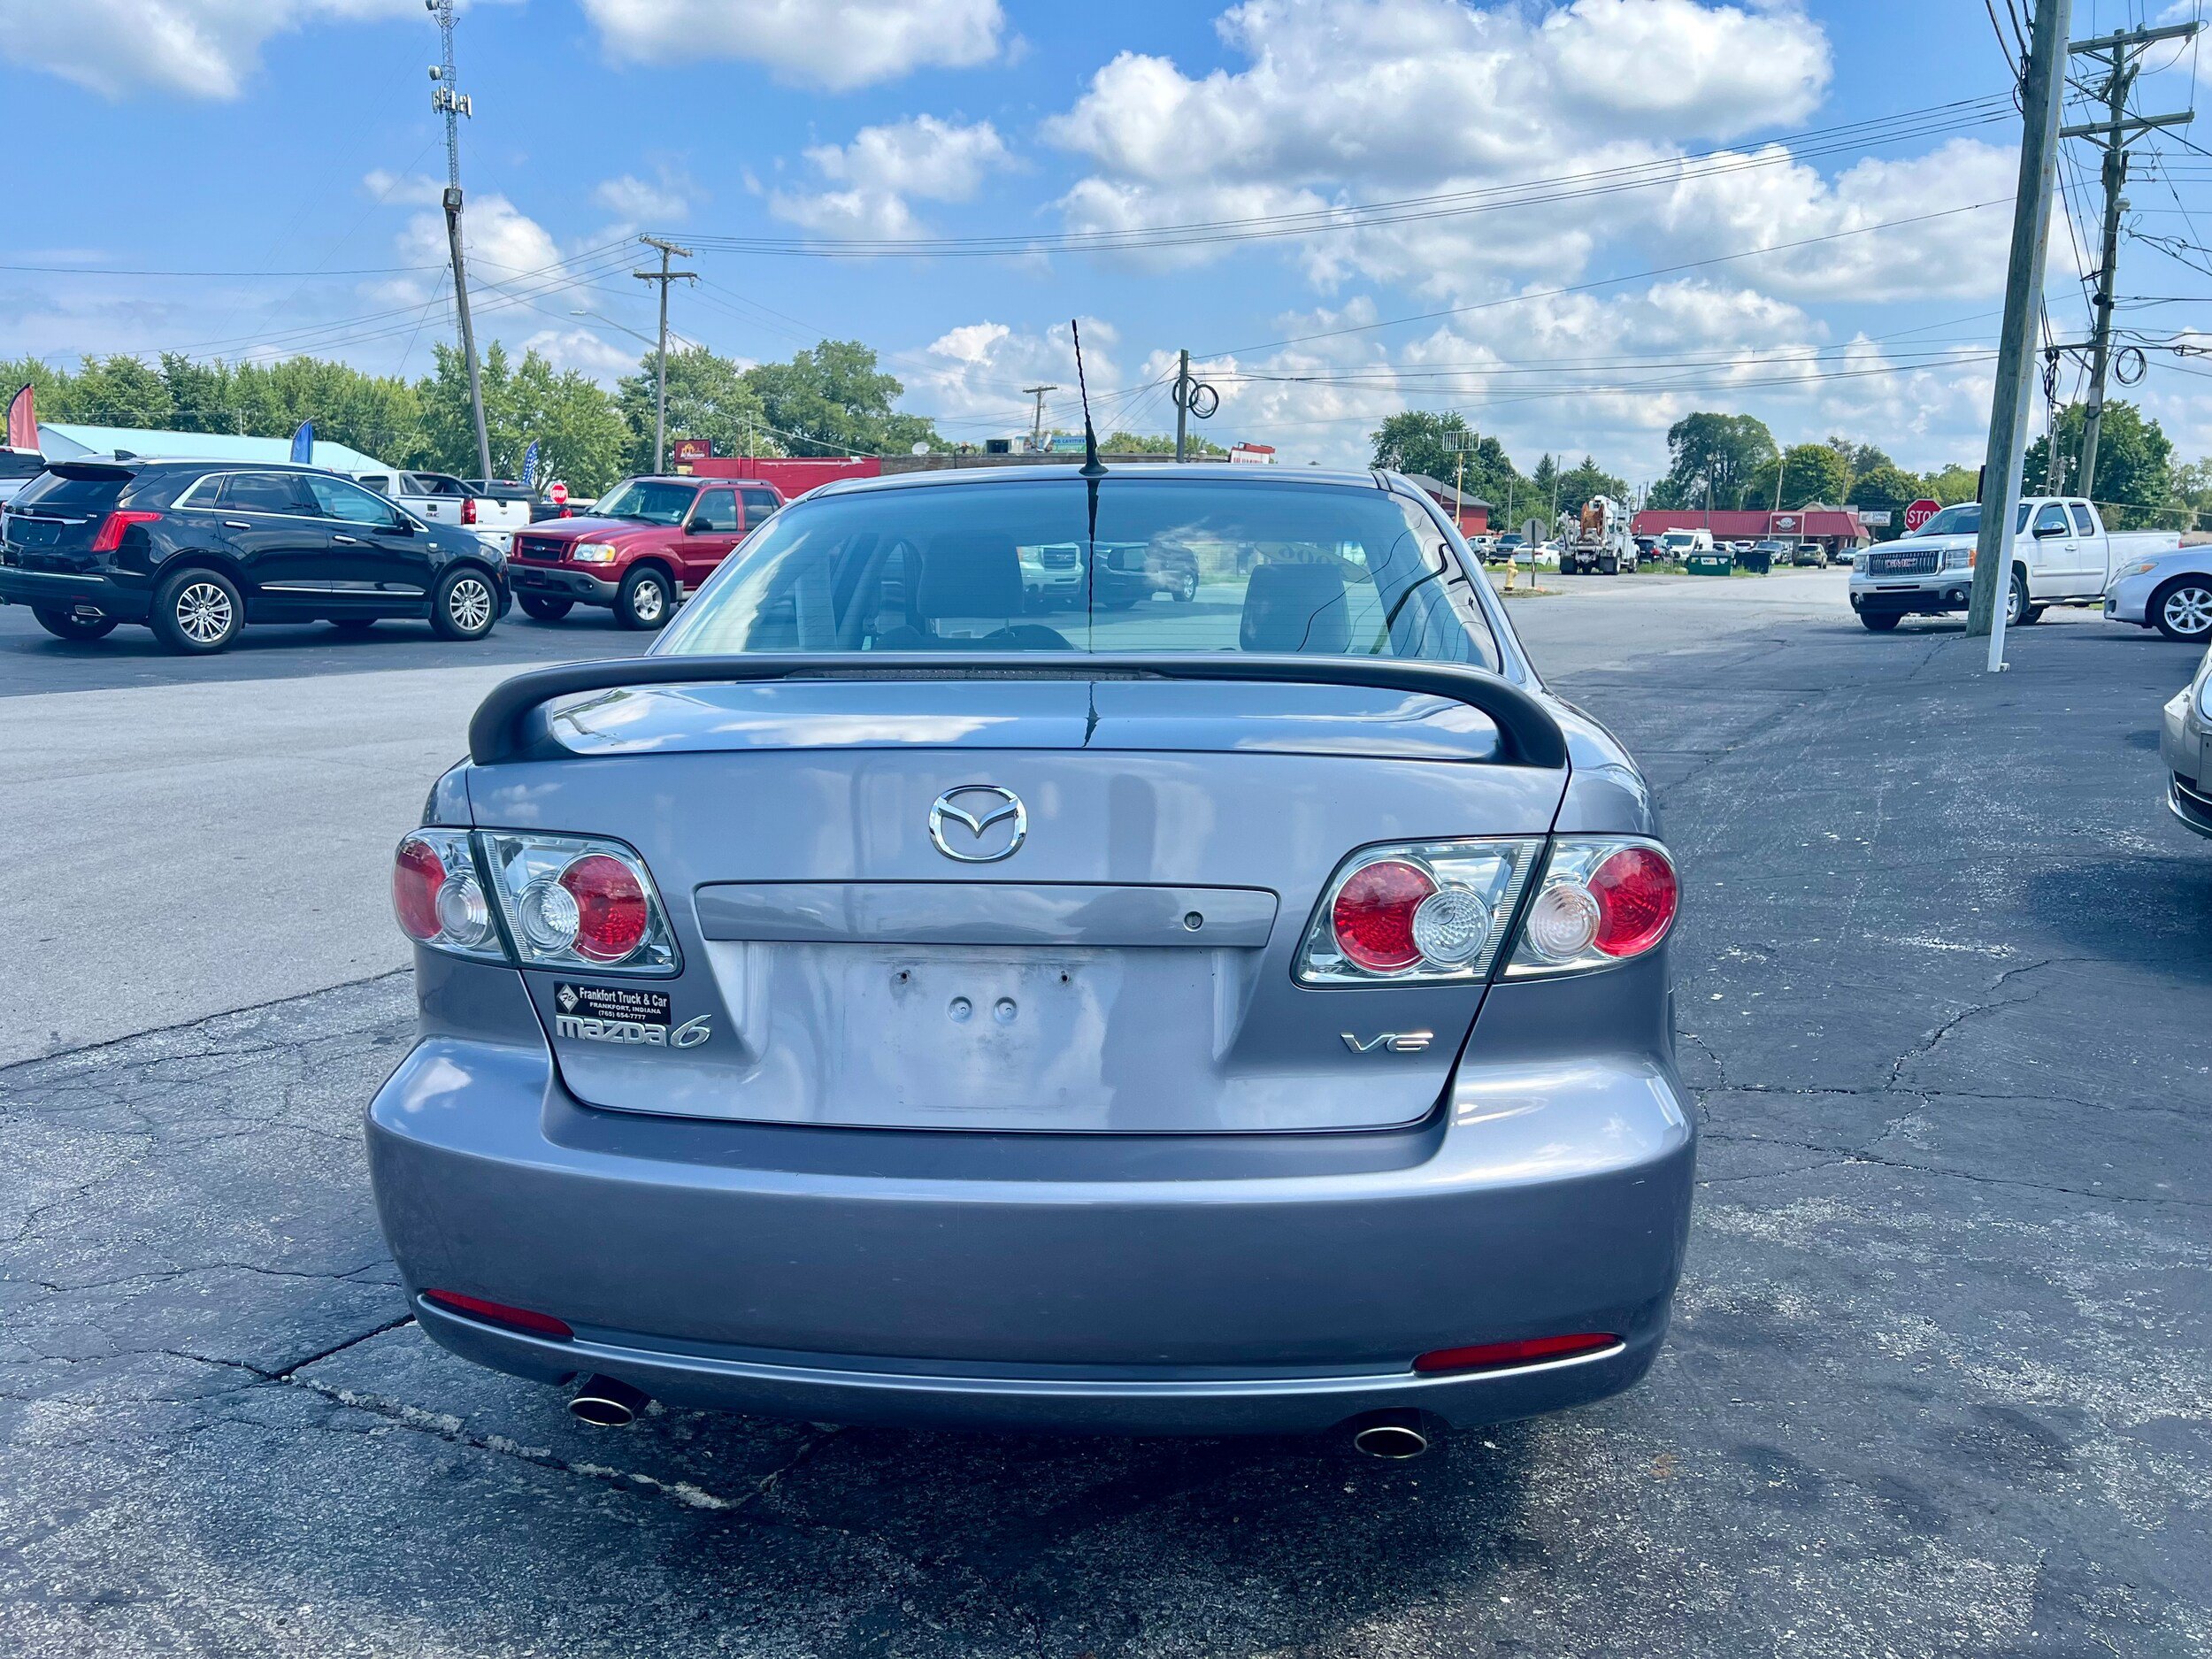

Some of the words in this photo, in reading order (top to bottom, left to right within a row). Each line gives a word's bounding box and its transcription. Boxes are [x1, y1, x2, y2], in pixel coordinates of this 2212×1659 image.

[552, 489, 566, 498] STOP
[1908, 510, 1939, 524] STO
[579, 987, 617, 1002] Frankfort
[618, 991, 641, 1005] Truck
[643, 995, 650, 1006] &
[651, 996, 668, 1008] Car
[589, 1002, 631, 1012] FRANKFORT,
[632, 1006, 662, 1015] INDIANA
[598, 1010, 615, 1018] (765)
[1340, 1032, 1433, 1054] V6
